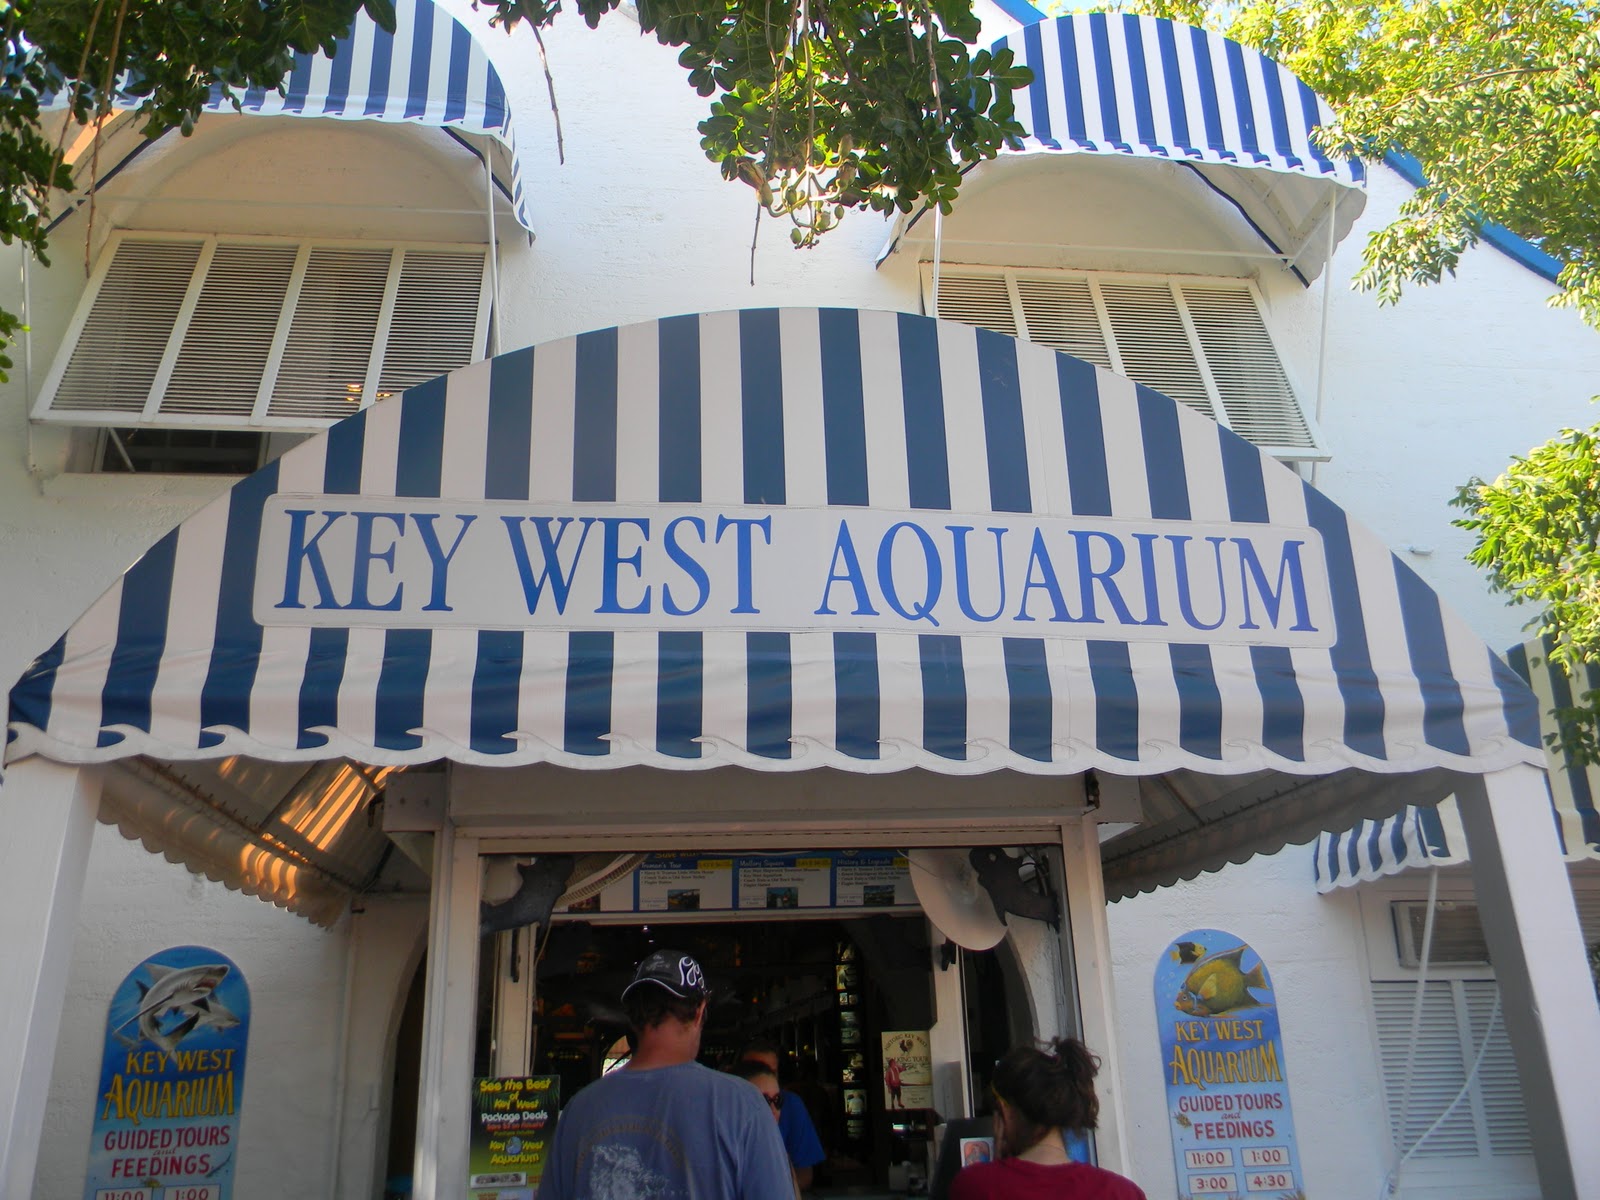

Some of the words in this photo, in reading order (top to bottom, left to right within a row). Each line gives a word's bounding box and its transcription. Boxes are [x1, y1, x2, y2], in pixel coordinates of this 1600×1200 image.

[274, 509, 478, 611] KEY
[500, 514, 772, 616] WEST
[814, 519, 1319, 632] AQUARIUM
[1175, 1021, 1210, 1042] KEY
[1215, 1020, 1263, 1041] WEST
[126, 1050, 170, 1075] KEY
[177, 1048, 236, 1073] WEST
[1169, 1040, 1283, 1091] AQUARIUM
[480, 1080, 502, 1092] See
[504, 1078, 524, 1091] the
[526, 1078, 552, 1090] Best
[102, 1070, 235, 1126] AQUARIUM
[509, 1091, 520, 1101] of
[1179, 1094, 1233, 1113] GUIDED
[1235, 1093, 1283, 1110] TOURS
[494, 1099, 511, 1110] Key
[516, 1099, 540, 1109] West
[481, 1111, 520, 1123] Package
[522, 1109, 548, 1120] Deals
[1221, 1110, 1241, 1120] and
[1194, 1120, 1275, 1139] FEEDINGS
[104, 1127, 172, 1151] GUIDED
[175, 1125, 232, 1148] TOURS
[489, 1141, 506, 1152] Key
[522, 1140, 545, 1151] West
[490, 1152, 539, 1166] Aquarium
[1191, 1152, 1225, 1165] 11:00
[1251, 1150, 1281, 1163] 1:00
[111, 1153, 211, 1178] FEEDINGS
[1196, 1177, 1228, 1190] 3:00
[1253, 1174, 1286, 1188] 4:30
[174, 1188, 210, 1200] 1:00
